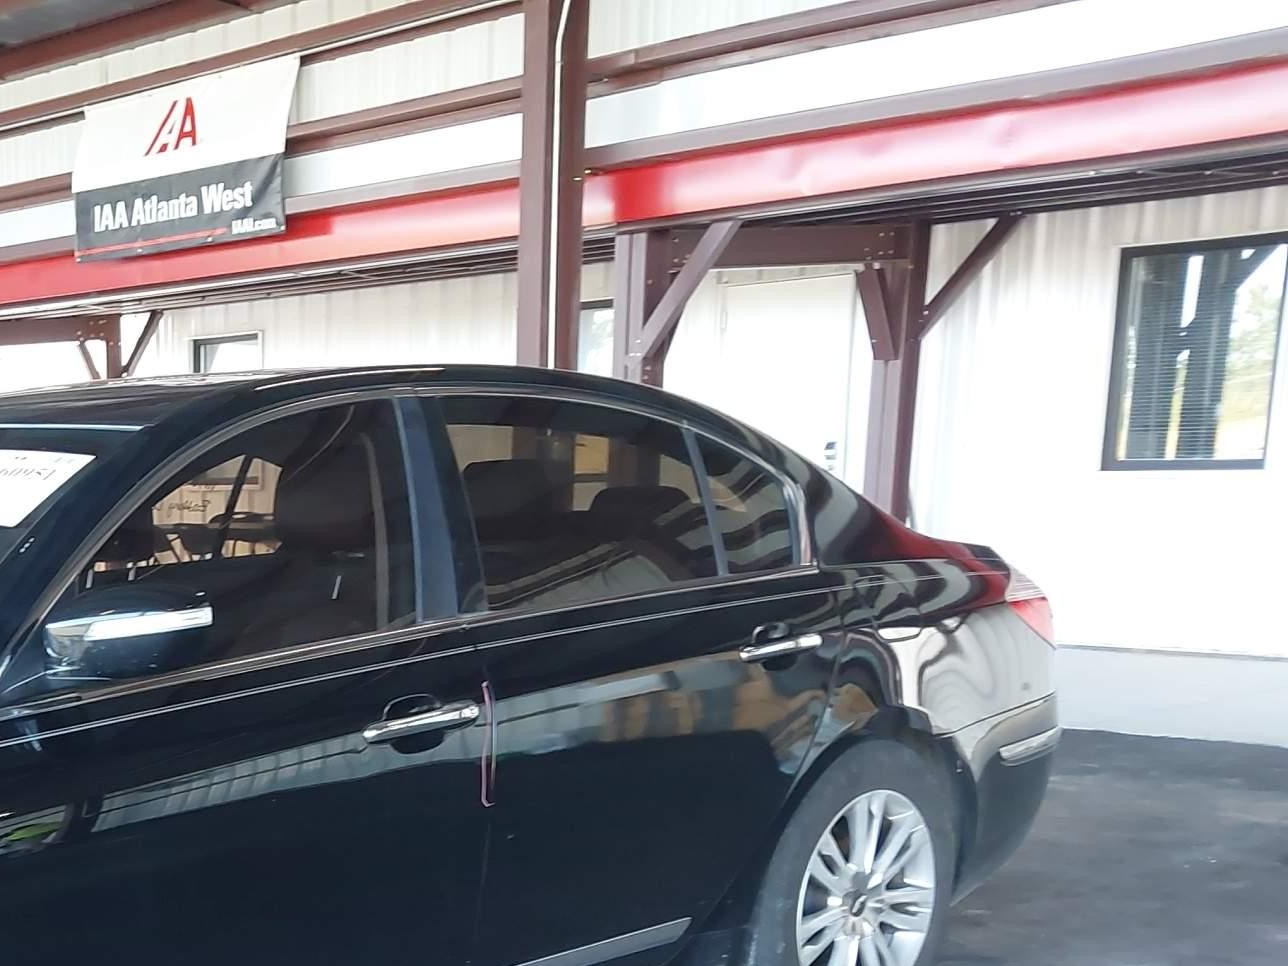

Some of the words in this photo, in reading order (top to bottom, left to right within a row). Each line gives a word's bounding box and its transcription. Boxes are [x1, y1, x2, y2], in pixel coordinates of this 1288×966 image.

[93, 200, 129, 233] IAA
[131, 193, 198, 227] Atlanta
[200, 180, 254, 215] West
